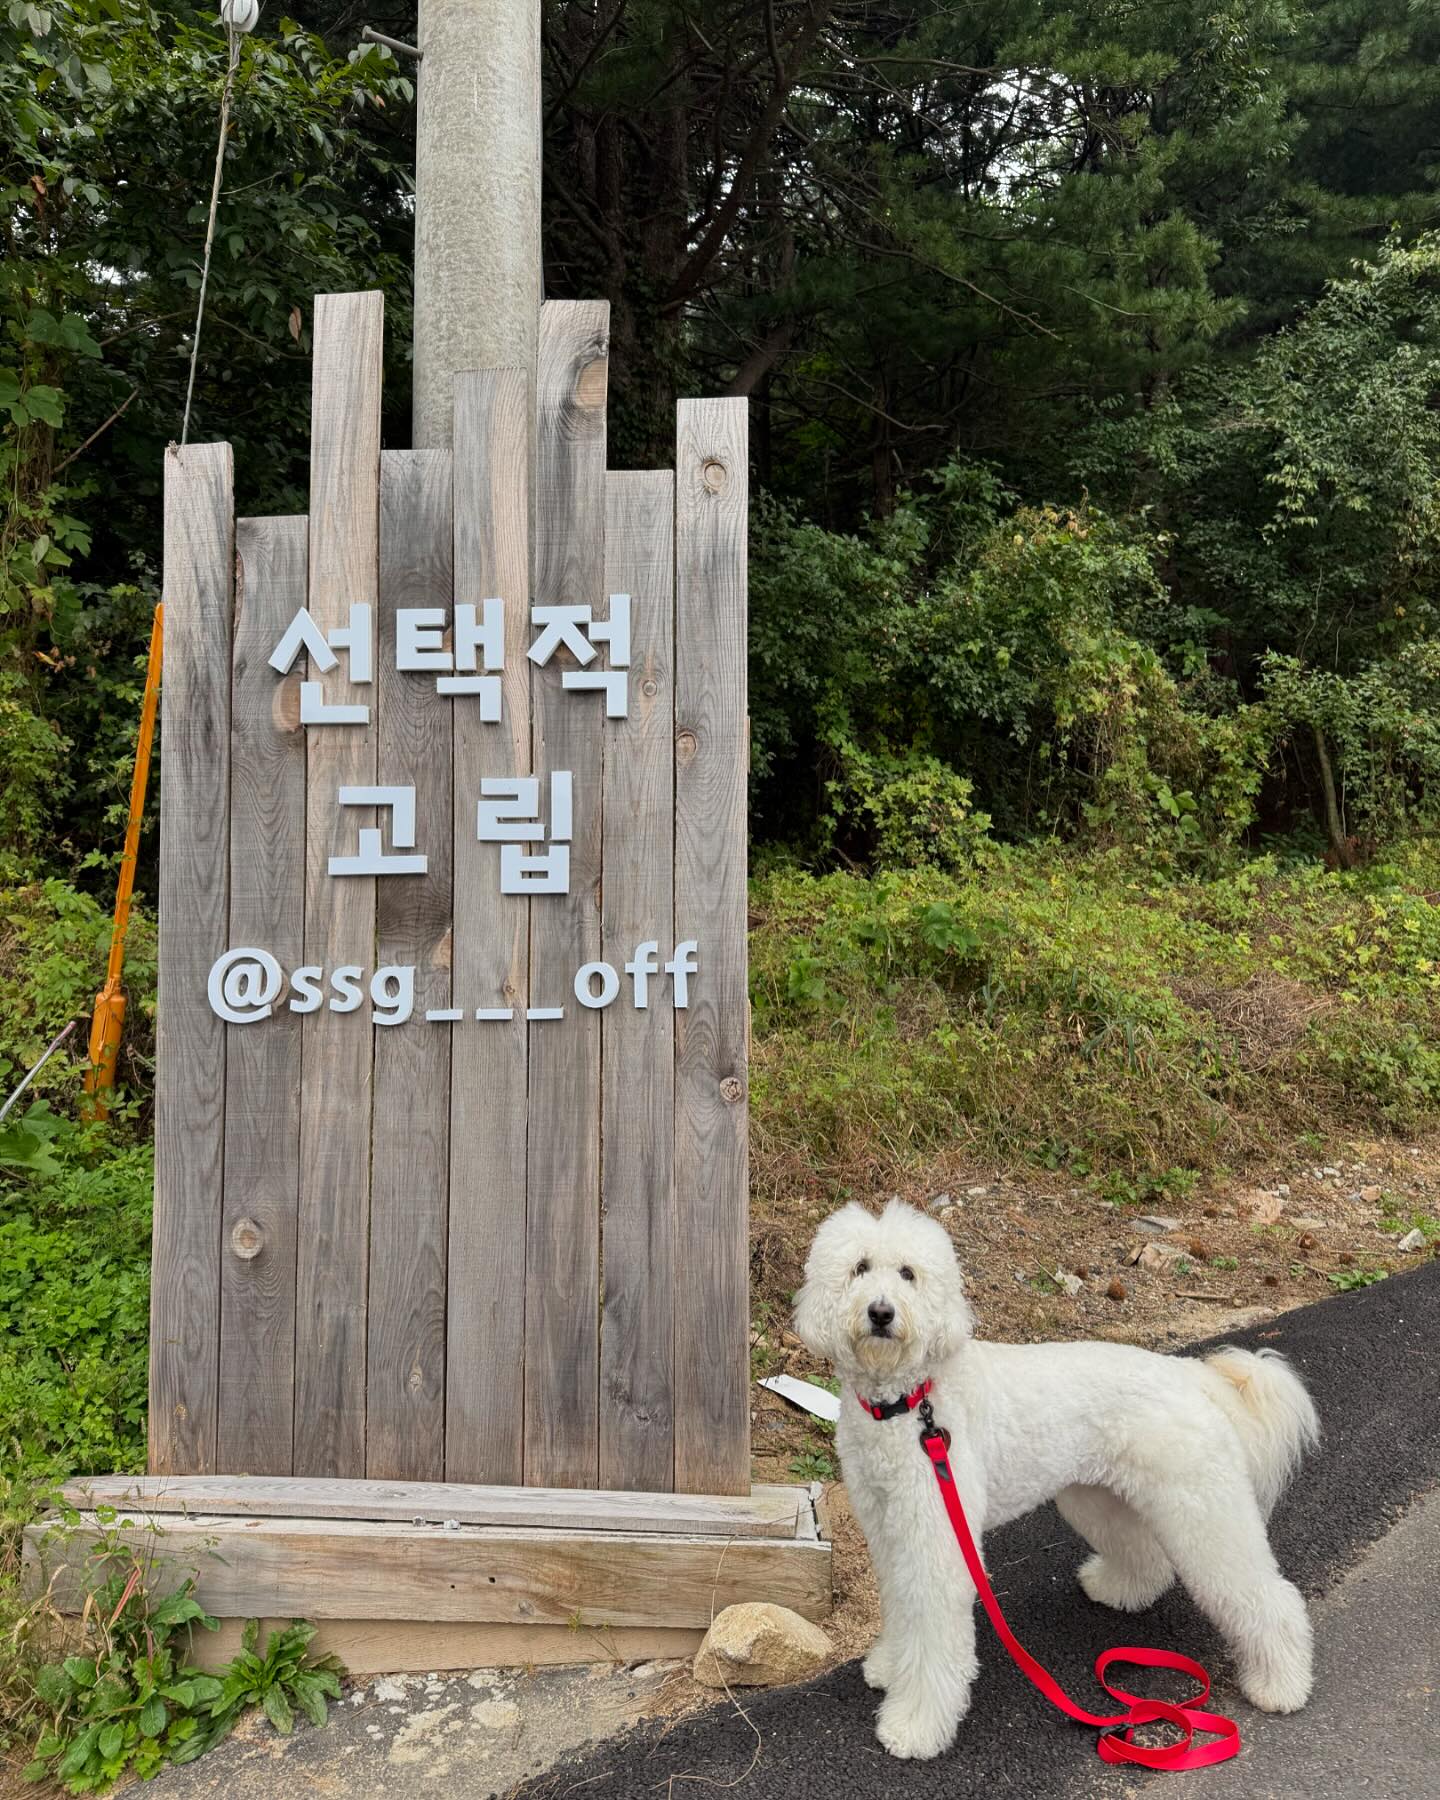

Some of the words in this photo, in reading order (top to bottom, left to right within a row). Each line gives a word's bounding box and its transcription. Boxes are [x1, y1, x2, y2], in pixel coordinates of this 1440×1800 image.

[268, 594, 631, 725] 선택적
[328, 771, 573, 895] 고립
[207, 940, 699, 1026] @ssg___off
